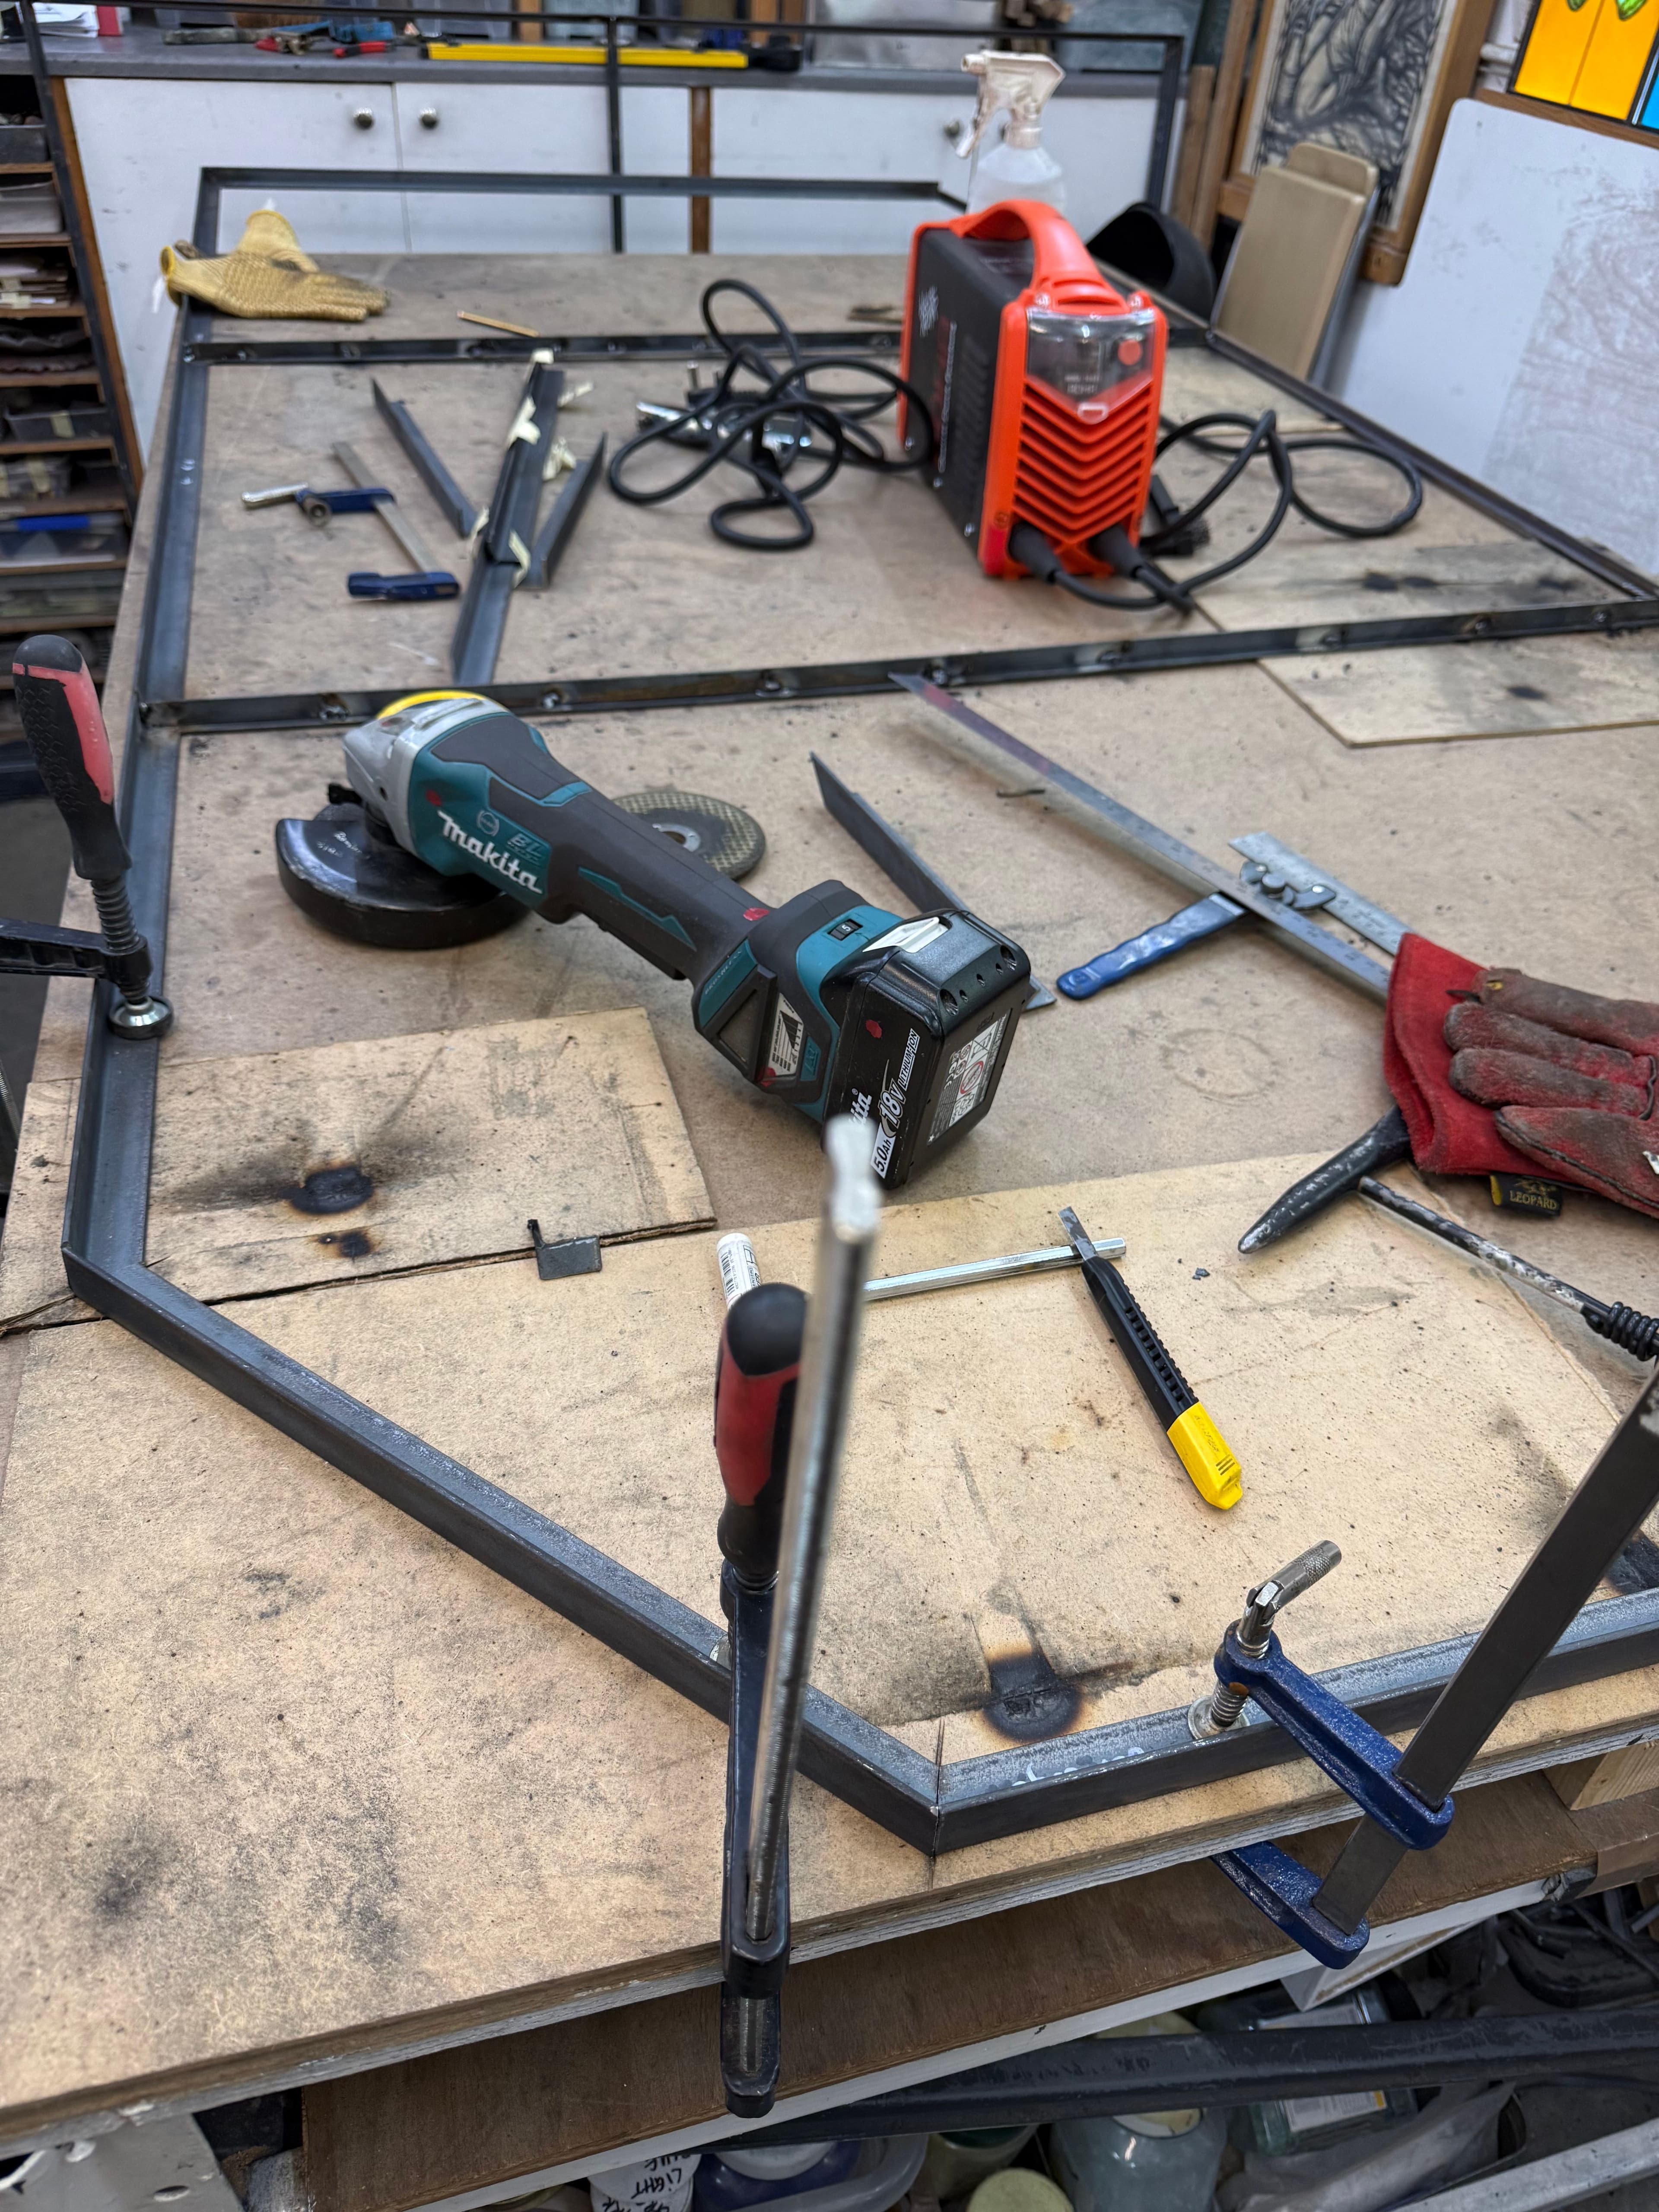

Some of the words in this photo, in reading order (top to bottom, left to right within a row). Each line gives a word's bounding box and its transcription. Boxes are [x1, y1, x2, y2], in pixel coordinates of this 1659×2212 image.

[898, 1030, 918, 1088] LITHIUM-ION
[879, 1081, 906, 1126] 18V
[874, 1139, 891, 1172] 5.0Ah
[1510, 1190, 1557, 1210] LEOPARD
